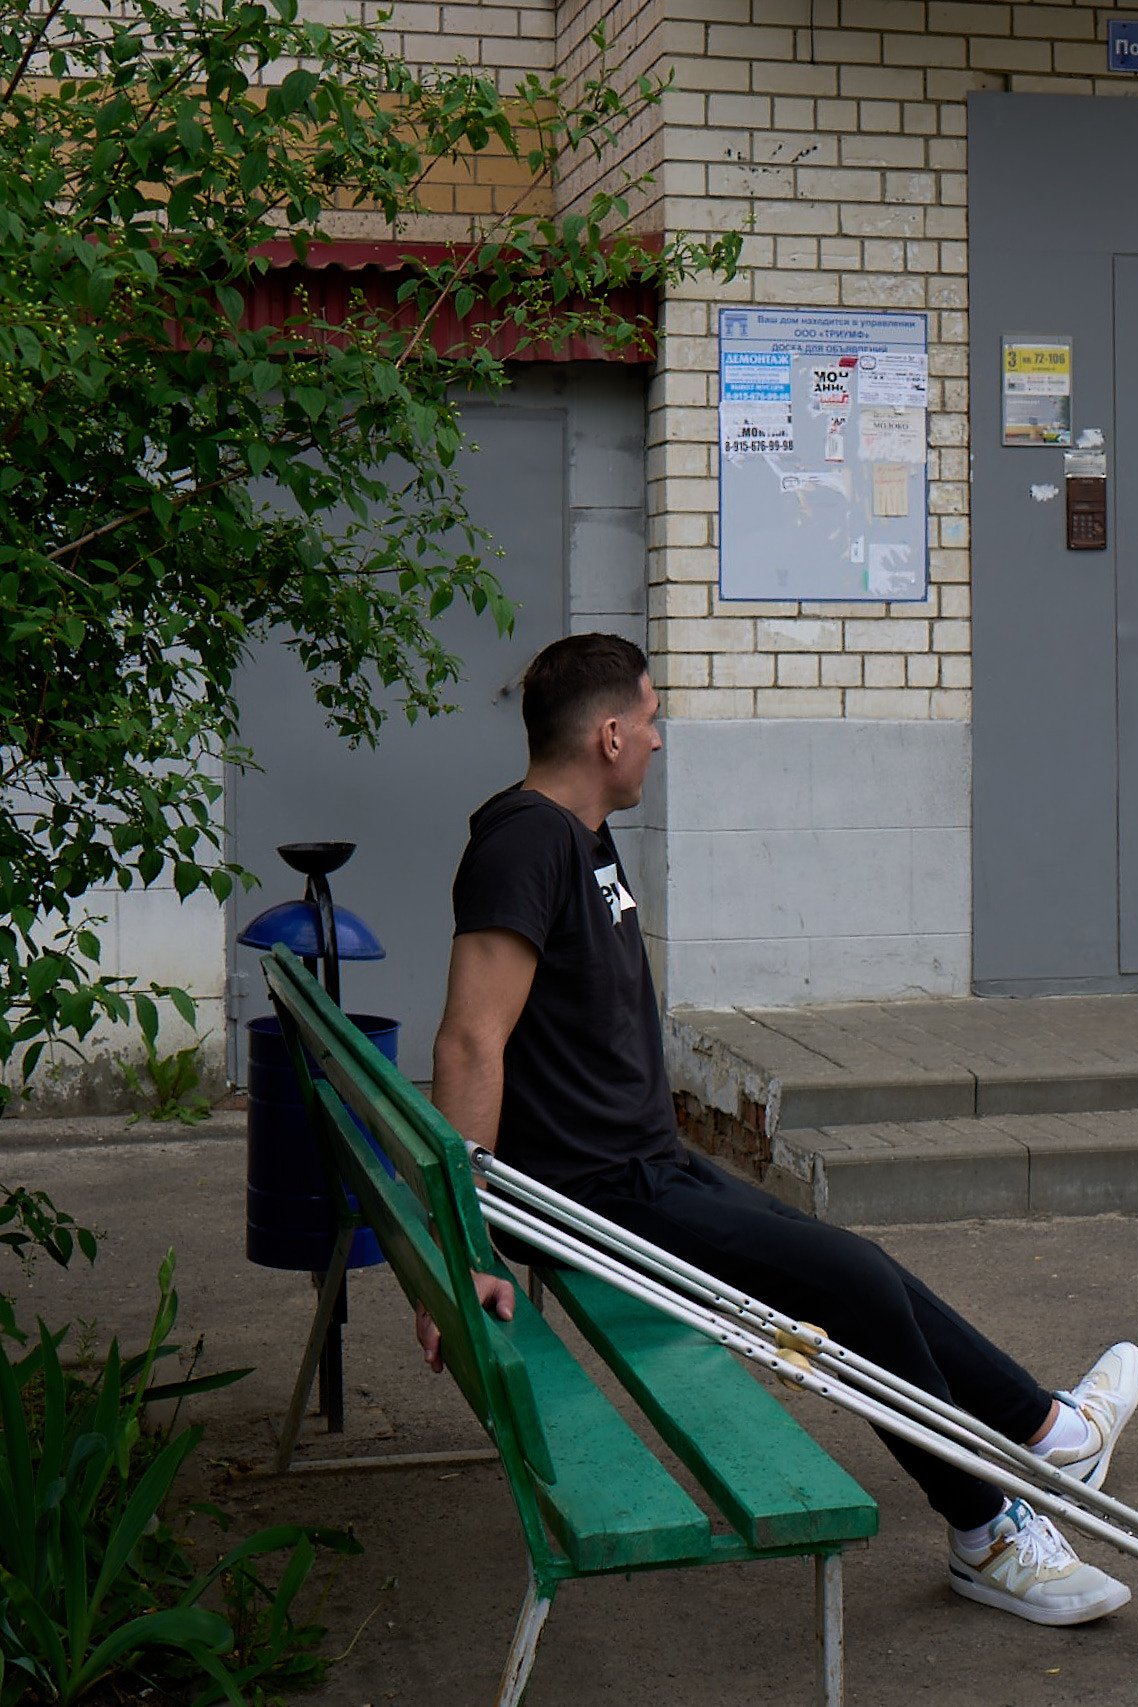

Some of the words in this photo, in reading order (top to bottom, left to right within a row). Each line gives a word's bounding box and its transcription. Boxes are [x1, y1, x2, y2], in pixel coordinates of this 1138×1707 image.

[757, 315, 778, 324] Ваш
[780, 317, 799, 325] дом
[801, 318, 850, 326] находится
[794, 329, 817, 337] ООО
[772, 344, 802, 352] ДОСКА
[804, 345, 824, 353] ДЛЯ
[1008, 350, 1017, 367] 3
